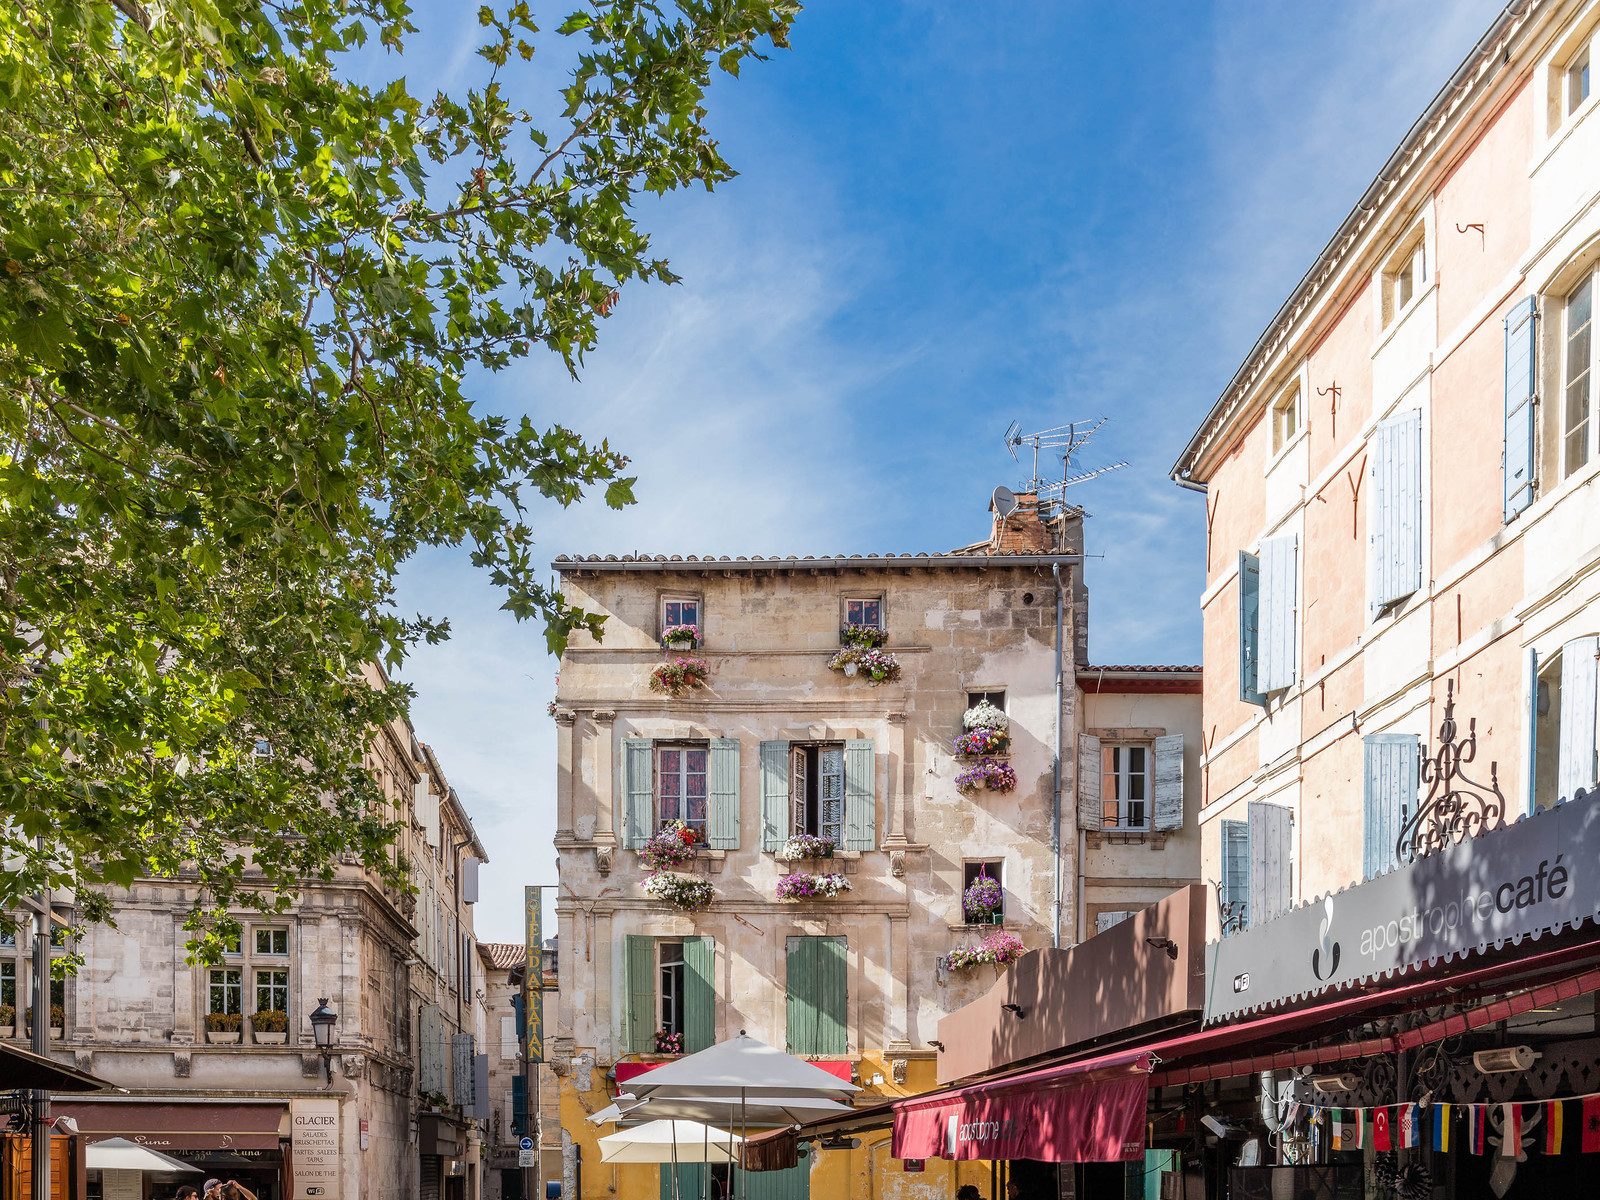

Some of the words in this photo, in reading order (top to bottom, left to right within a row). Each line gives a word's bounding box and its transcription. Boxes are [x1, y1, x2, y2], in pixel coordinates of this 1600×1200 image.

[526, 887, 541, 948] HOTEL
[295, 1116, 336, 1125] GLACIER
[134, 1135, 171, 1145] Luna
